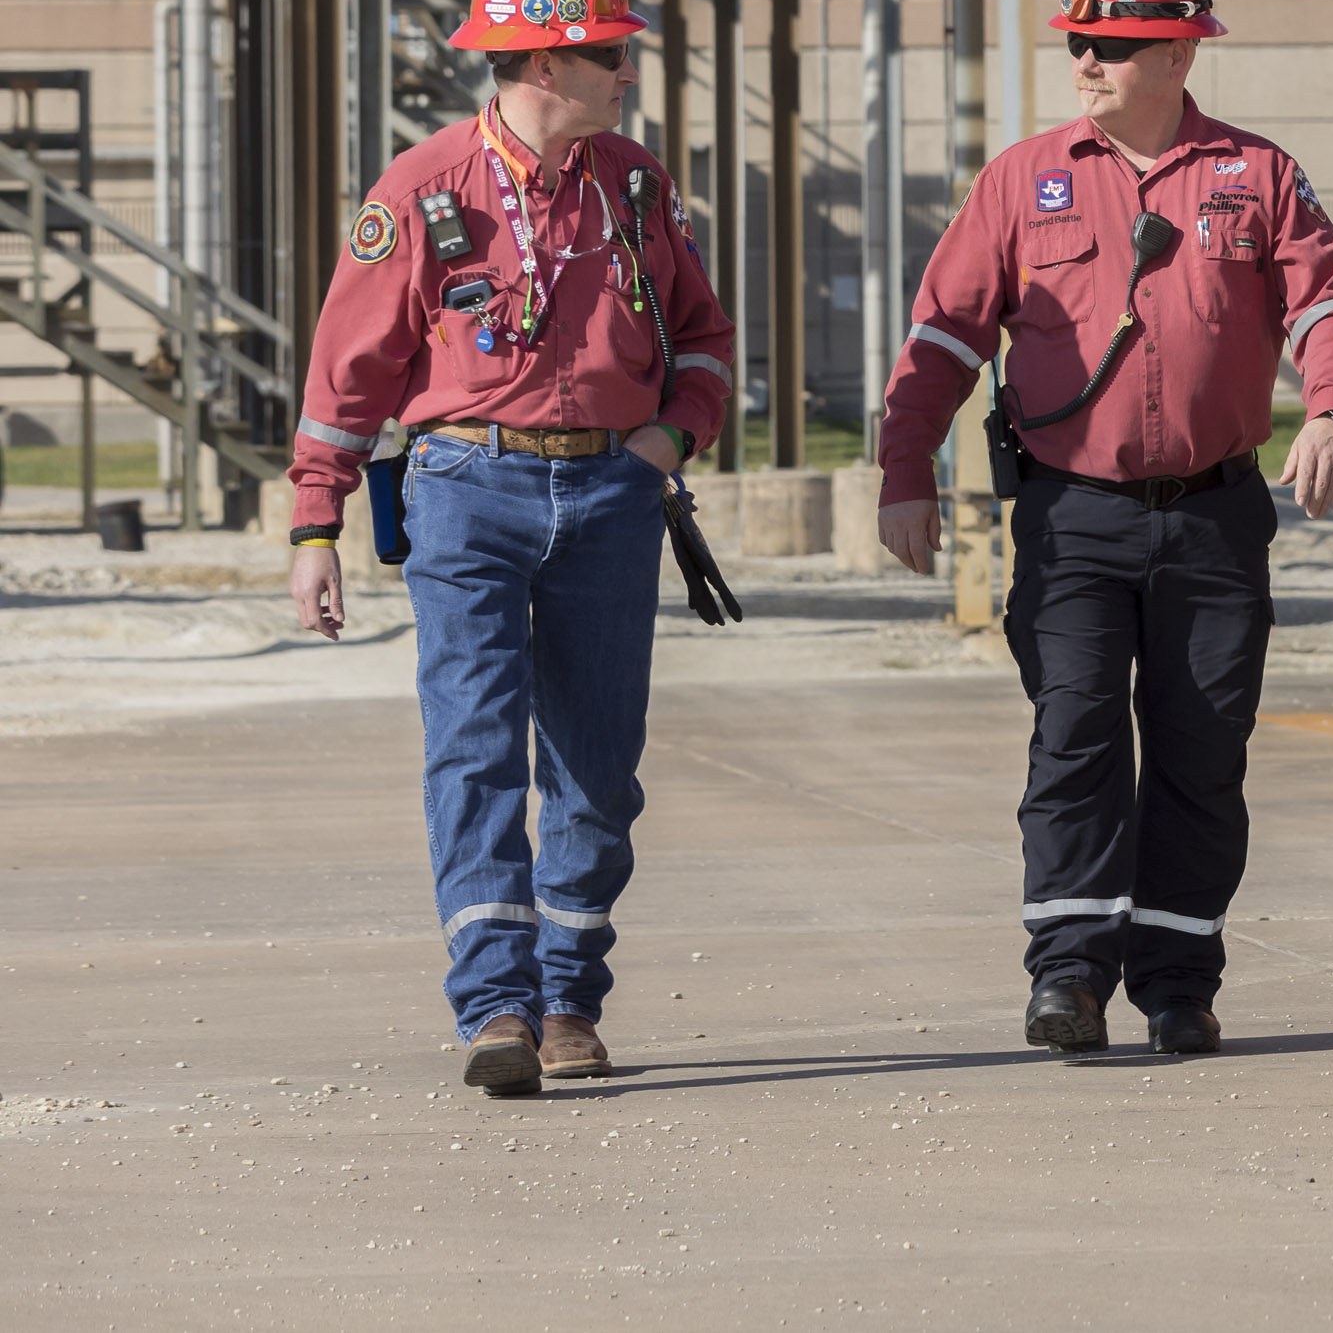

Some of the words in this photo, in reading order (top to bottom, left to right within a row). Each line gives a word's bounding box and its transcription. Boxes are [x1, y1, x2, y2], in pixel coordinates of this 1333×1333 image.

[491, 157, 509, 187] AGGIES
[1211, 192, 1259, 203] Chevron
[1198, 201, 1246, 214] Phillips
[1028, 215, 1054, 229] David
[1054, 214, 1082, 224] Battle
[511, 218, 528, 250] AGGIES
